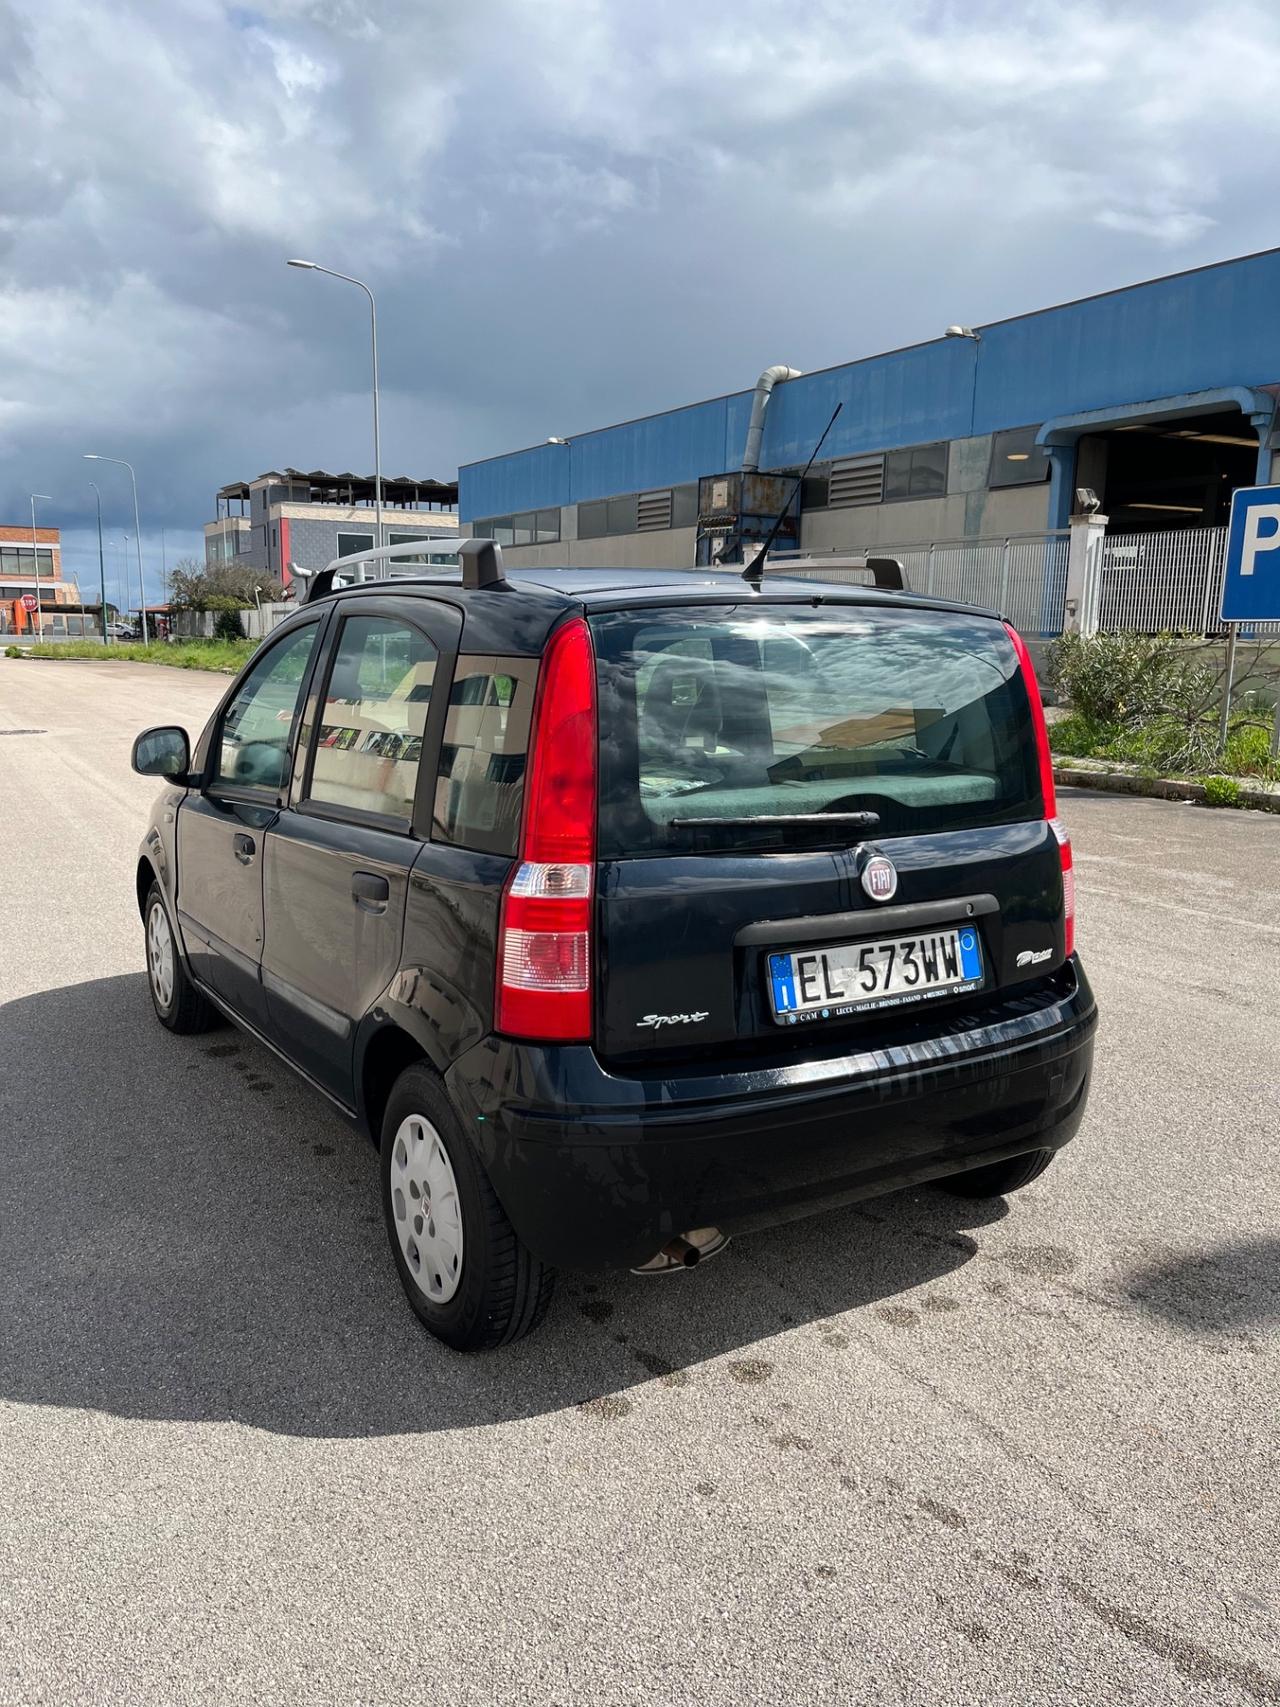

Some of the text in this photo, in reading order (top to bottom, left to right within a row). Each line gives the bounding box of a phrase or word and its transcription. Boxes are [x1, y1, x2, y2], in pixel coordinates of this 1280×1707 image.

[1240, 503, 1280, 575] P
[870, 868, 890, 890] FIAT
[797, 935, 959, 1003] EL 573WW
[636, 1011, 709, 1029] Sport
